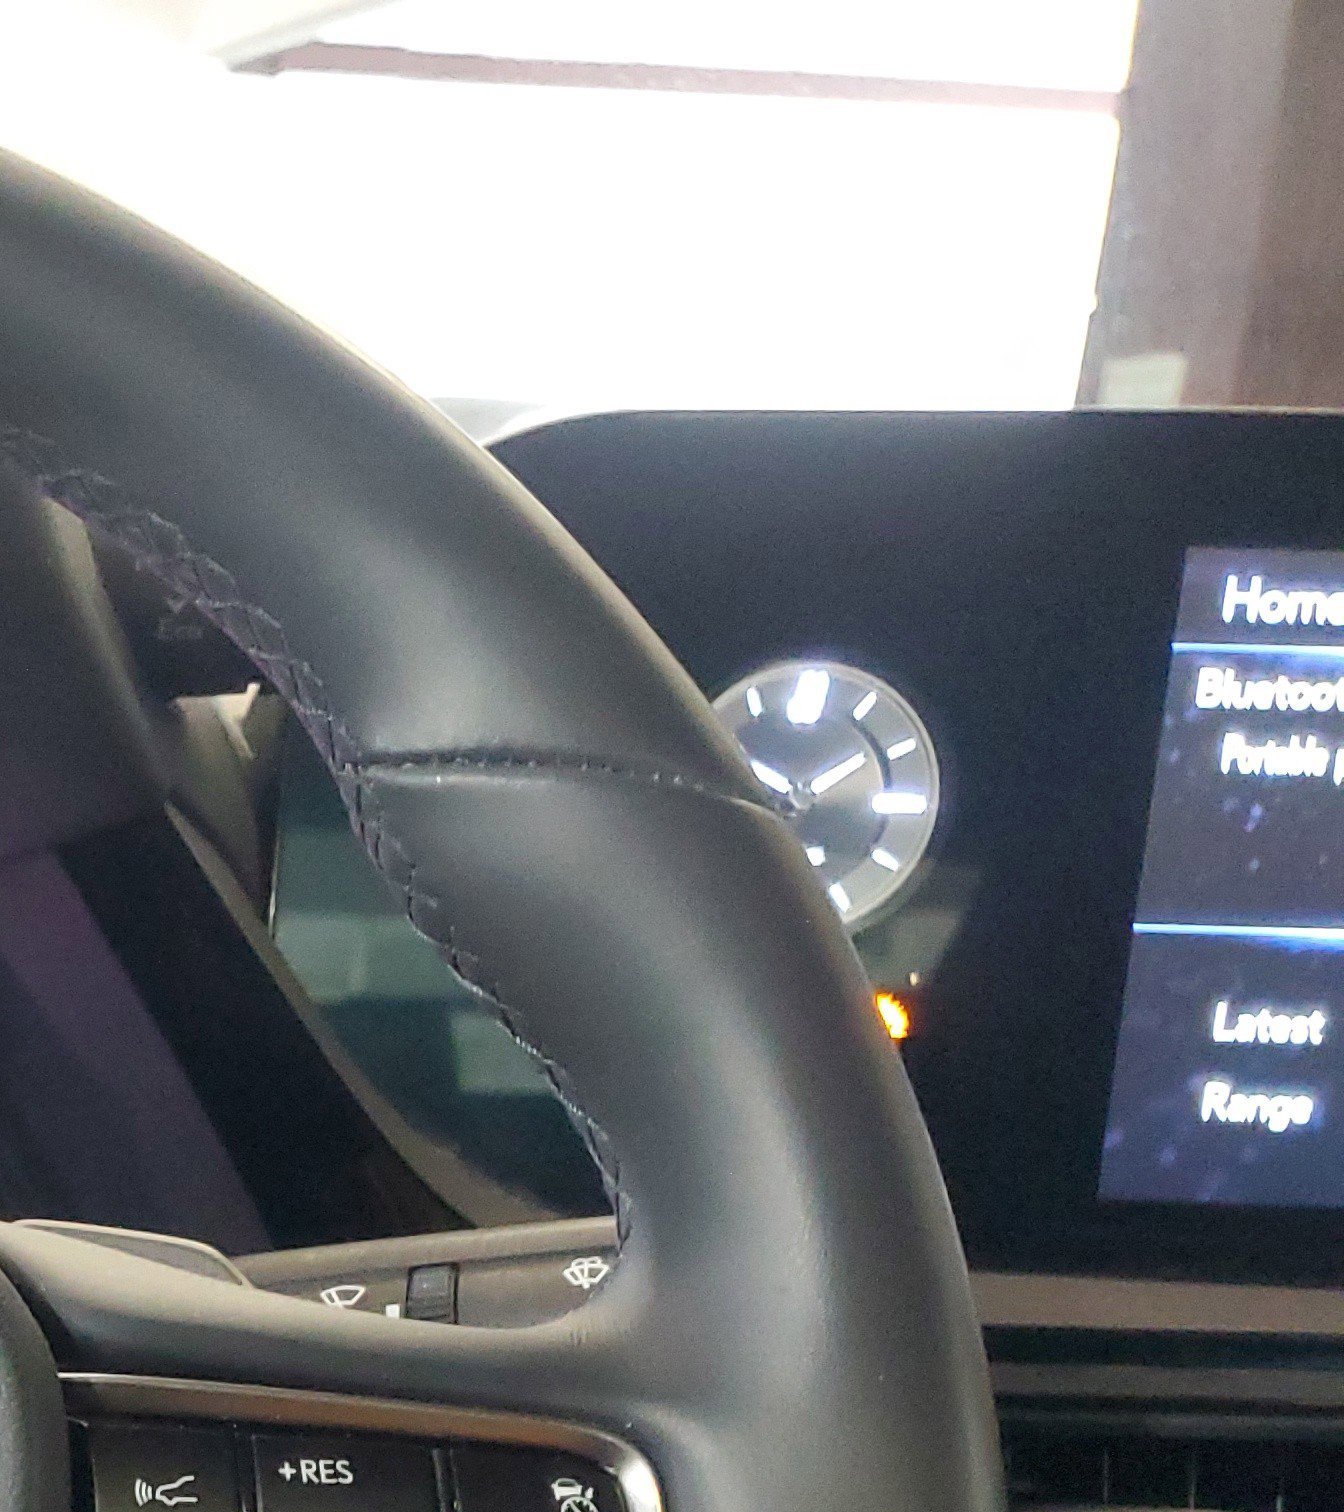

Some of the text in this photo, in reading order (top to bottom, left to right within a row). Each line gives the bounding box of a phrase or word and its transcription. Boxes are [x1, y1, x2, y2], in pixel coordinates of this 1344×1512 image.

[1222, 574, 1344, 626] Home
[1212, 1000, 1326, 1046] Latest
[1201, 1081, 1314, 1133] Range
[278, 1459, 354, 1485] +RES
